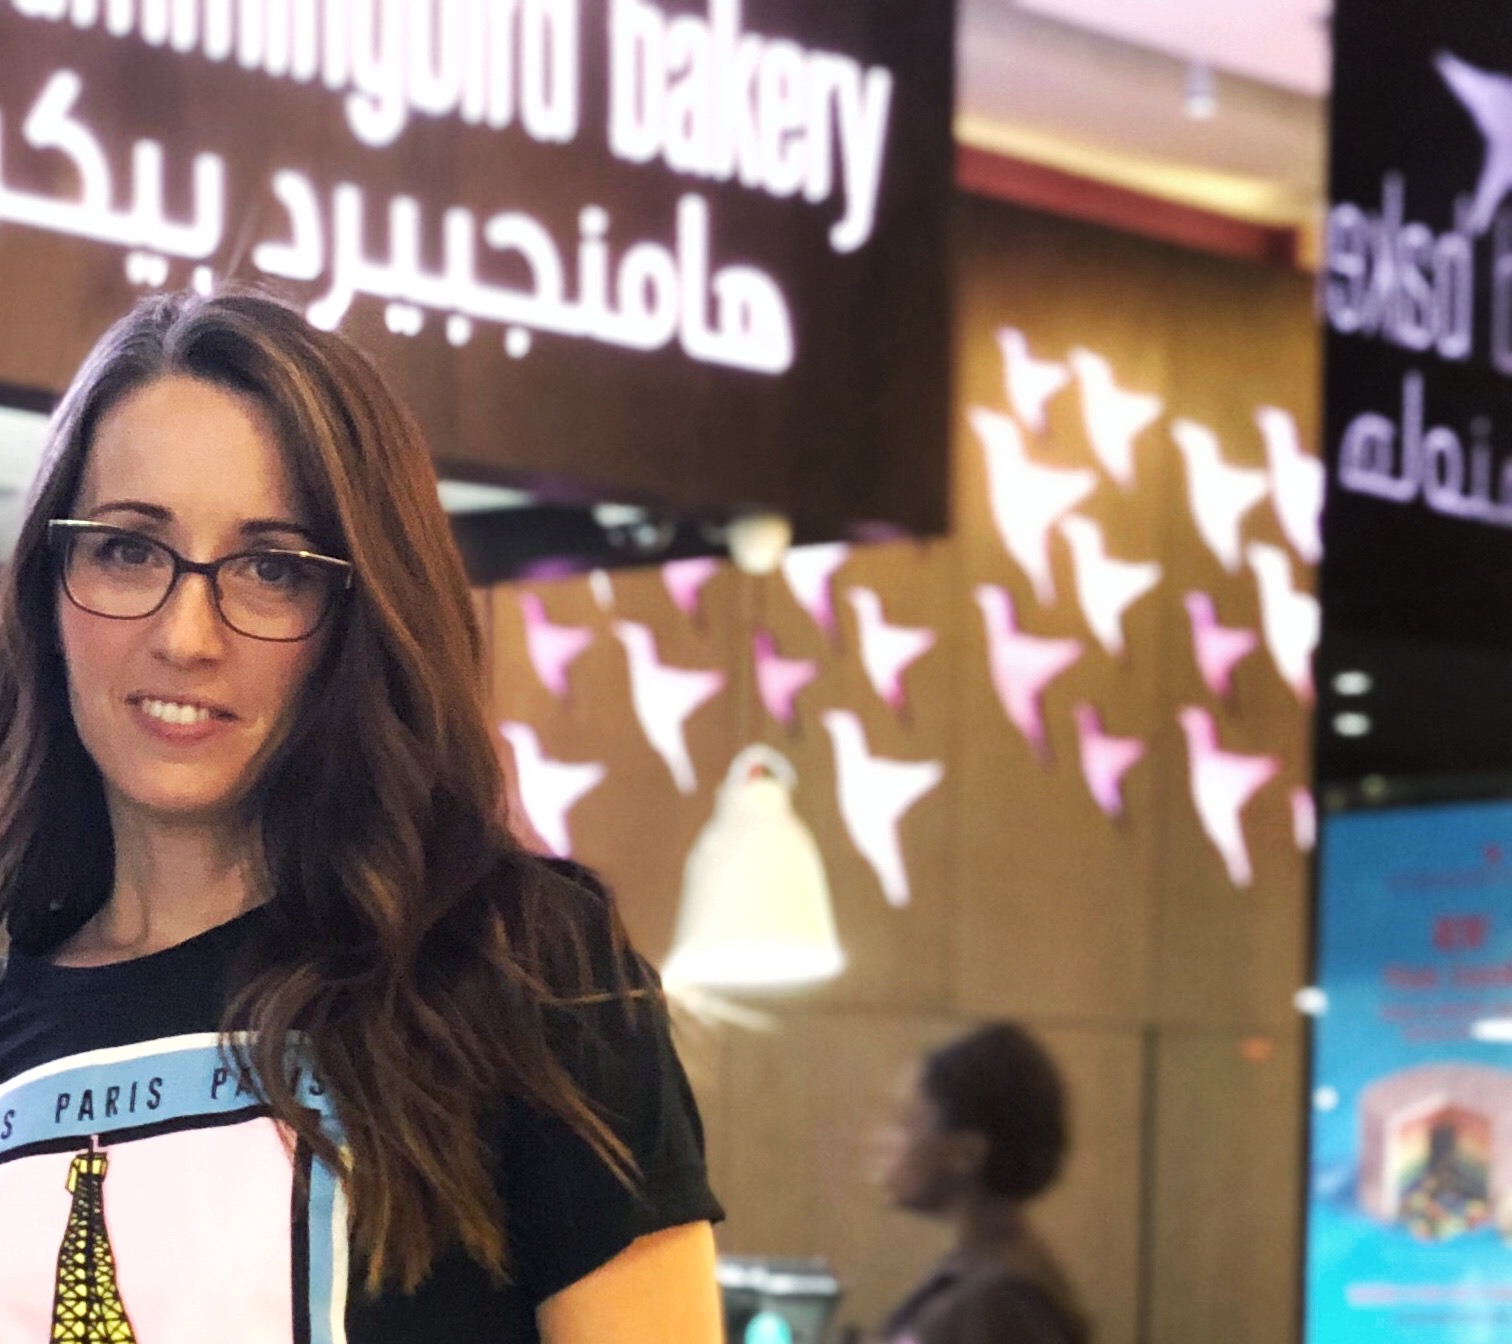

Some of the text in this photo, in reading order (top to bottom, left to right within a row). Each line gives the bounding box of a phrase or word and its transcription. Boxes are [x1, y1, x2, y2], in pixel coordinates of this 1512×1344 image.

[609, 0, 891, 254] bakery
[252, 168, 794, 376] هامنجبيرد
[54, 1076, 164, 1125] PARIS
